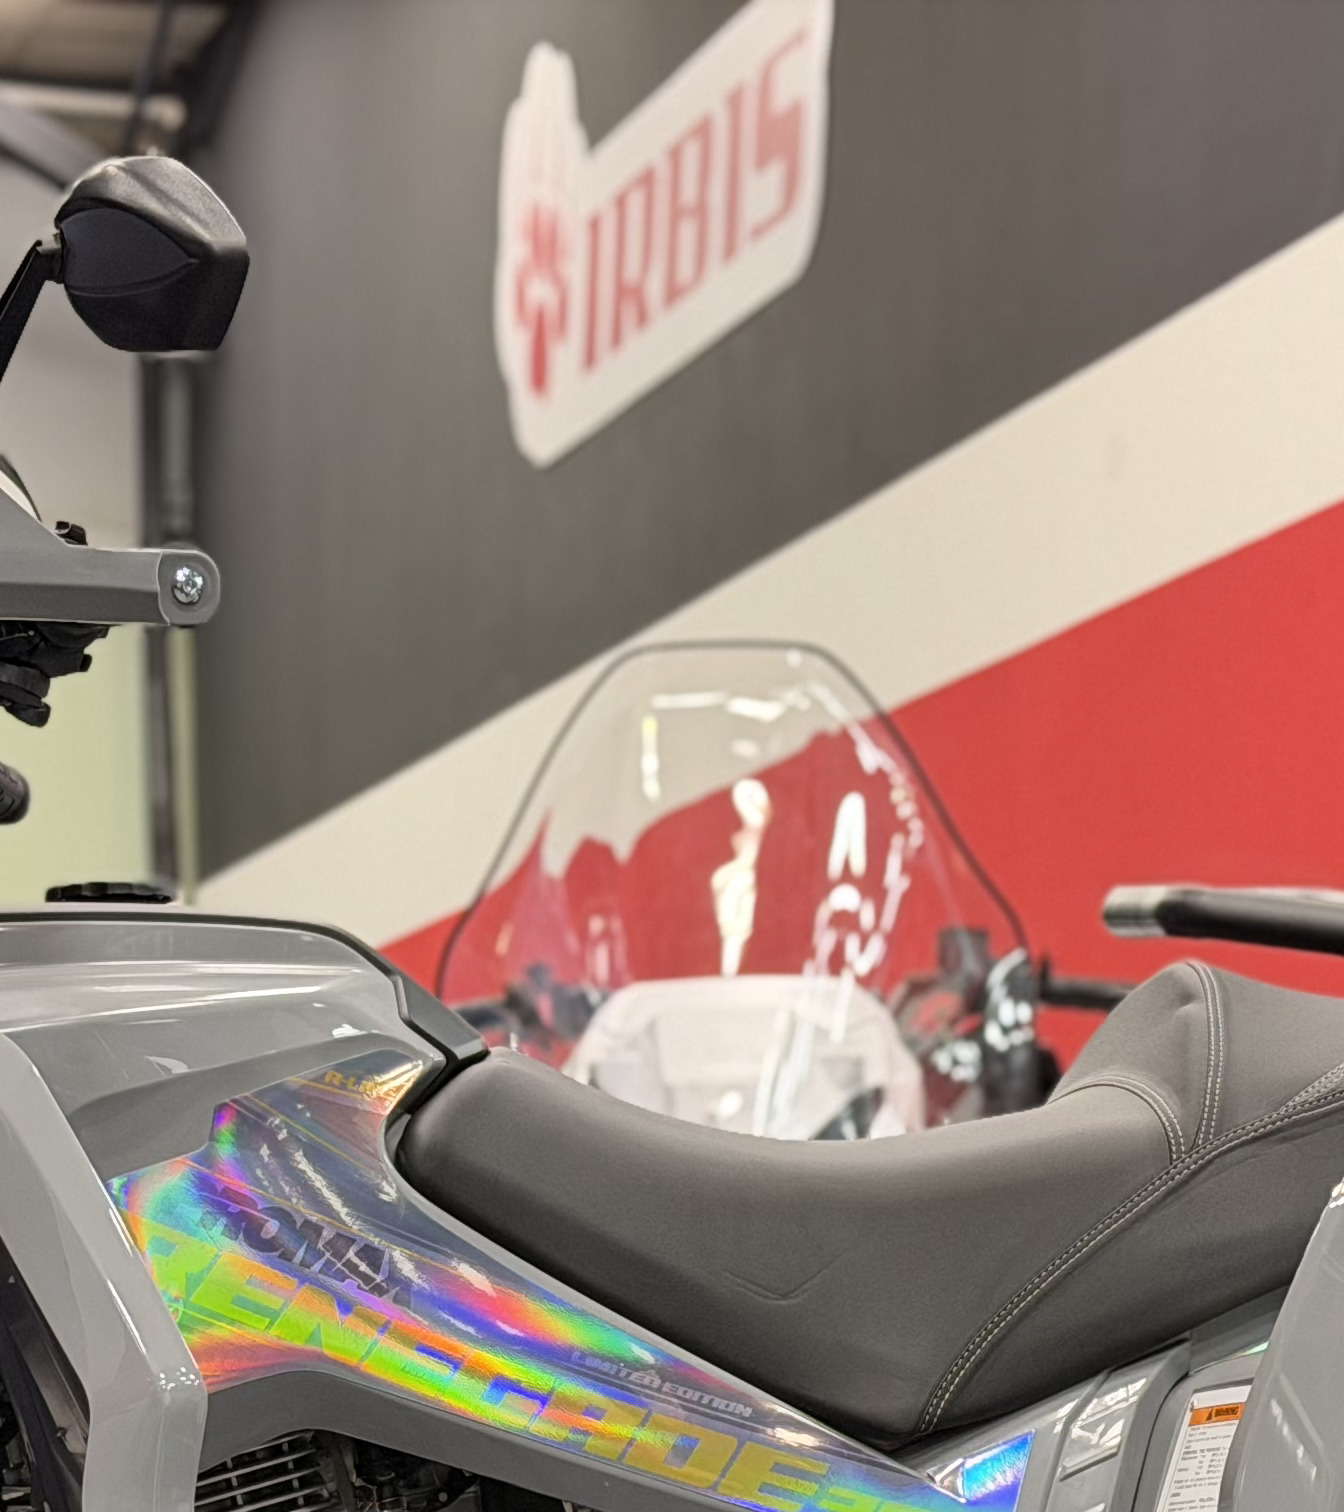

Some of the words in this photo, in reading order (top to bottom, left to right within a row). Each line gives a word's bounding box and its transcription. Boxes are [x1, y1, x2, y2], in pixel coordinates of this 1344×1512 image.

[582, 28, 810, 372] IRBIS
[572, 1351, 662, 1391] LIMITED
[661, 1380, 754, 1418] EDITION
